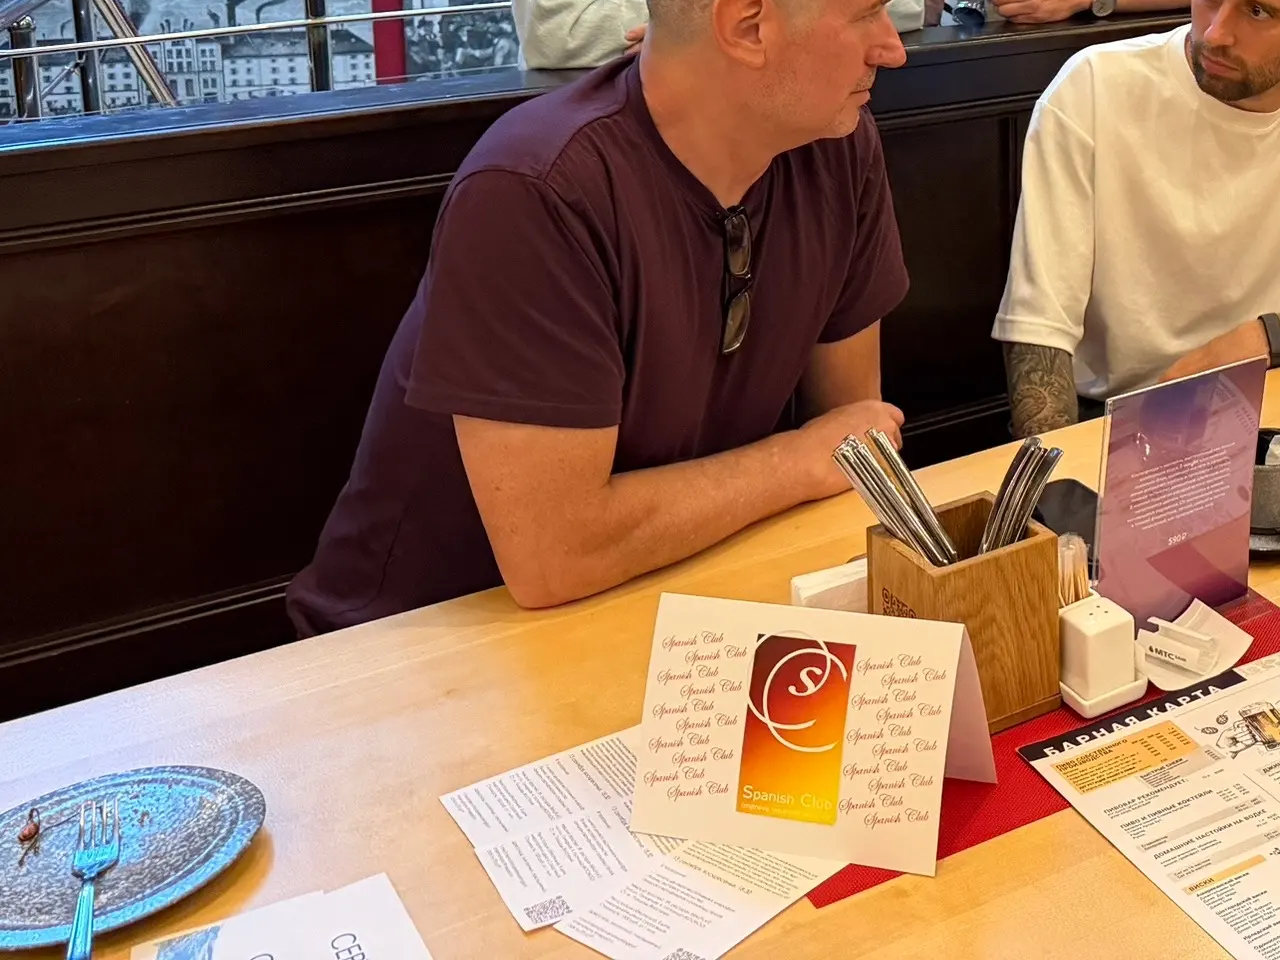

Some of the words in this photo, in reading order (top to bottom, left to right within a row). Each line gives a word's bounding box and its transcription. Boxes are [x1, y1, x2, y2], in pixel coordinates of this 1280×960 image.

[662, 635, 697, 652] Spanish
[701, 631, 723, 644] Club
[685, 649, 720, 666] Spanish
[724, 645, 747, 658] Club
[856, 657, 894, 676] Spanish
[897, 653, 922, 668] Club
[657, 669, 692, 686] Spanish
[696, 664, 719, 678] Club
[881, 672, 919, 690] Spanish
[922, 667, 947, 681] Club
[680, 683, 715, 700] Spanish
[719, 679, 742, 692] Club
[851, 693, 889, 711] Spanish
[892, 688, 917, 702] Club
[652, 702, 688, 719] Spanish
[691, 698, 714, 712] Club
[876, 707, 914, 725] Spanish
[917, 702, 942, 717] Club
[676, 717, 711, 734] Spanish
[714, 713, 738, 727] Club
[1043, 716, 1139, 758] БАРНАЯ
[1147, 684, 1223, 719] КАРТА
[648, 736, 684, 754] Spanish
[687, 732, 710, 746] Club
[846, 727, 884, 746] Spanish
[888, 723, 912, 737] Club
[672, 750, 707, 768] Spanish
[710, 747, 734, 761] Club
[872, 742, 909, 760] Spanish
[913, 738, 937, 752] Club
[644, 769, 679, 787] Spanish
[682, 766, 705, 780] Club
[843, 762, 880, 780] Spanish
[884, 759, 908, 773] Club
[667, 784, 702, 802] Spanish
[706, 781, 729, 795] Club
[868, 776, 905, 795] Spanish
[909, 773, 933, 787] Club
[743, 785, 794, 805] Spanish
[800, 792, 833, 810] Club
[838, 797, 876, 815] Spanish
[879, 793, 903, 807] Club
[1103, 798, 1136, 814] ПИВОВАР
[864, 812, 901, 830] Spanish
[904, 808, 929, 822] Club
[1120, 818, 1140, 829] ПИВО
[1149, 804, 1176, 820] ПИВНЫЕ
[1177, 789, 1213, 807] КОКТЕЙЛИ
[1154, 838, 1195, 860] ДОМАШНИЕ
[1195, 823, 1233, 842] НАСТОЙКИ
[1244, 808, 1267, 822] ВОДКЕ
[1188, 877, 1215, 892] ВИСКИ
